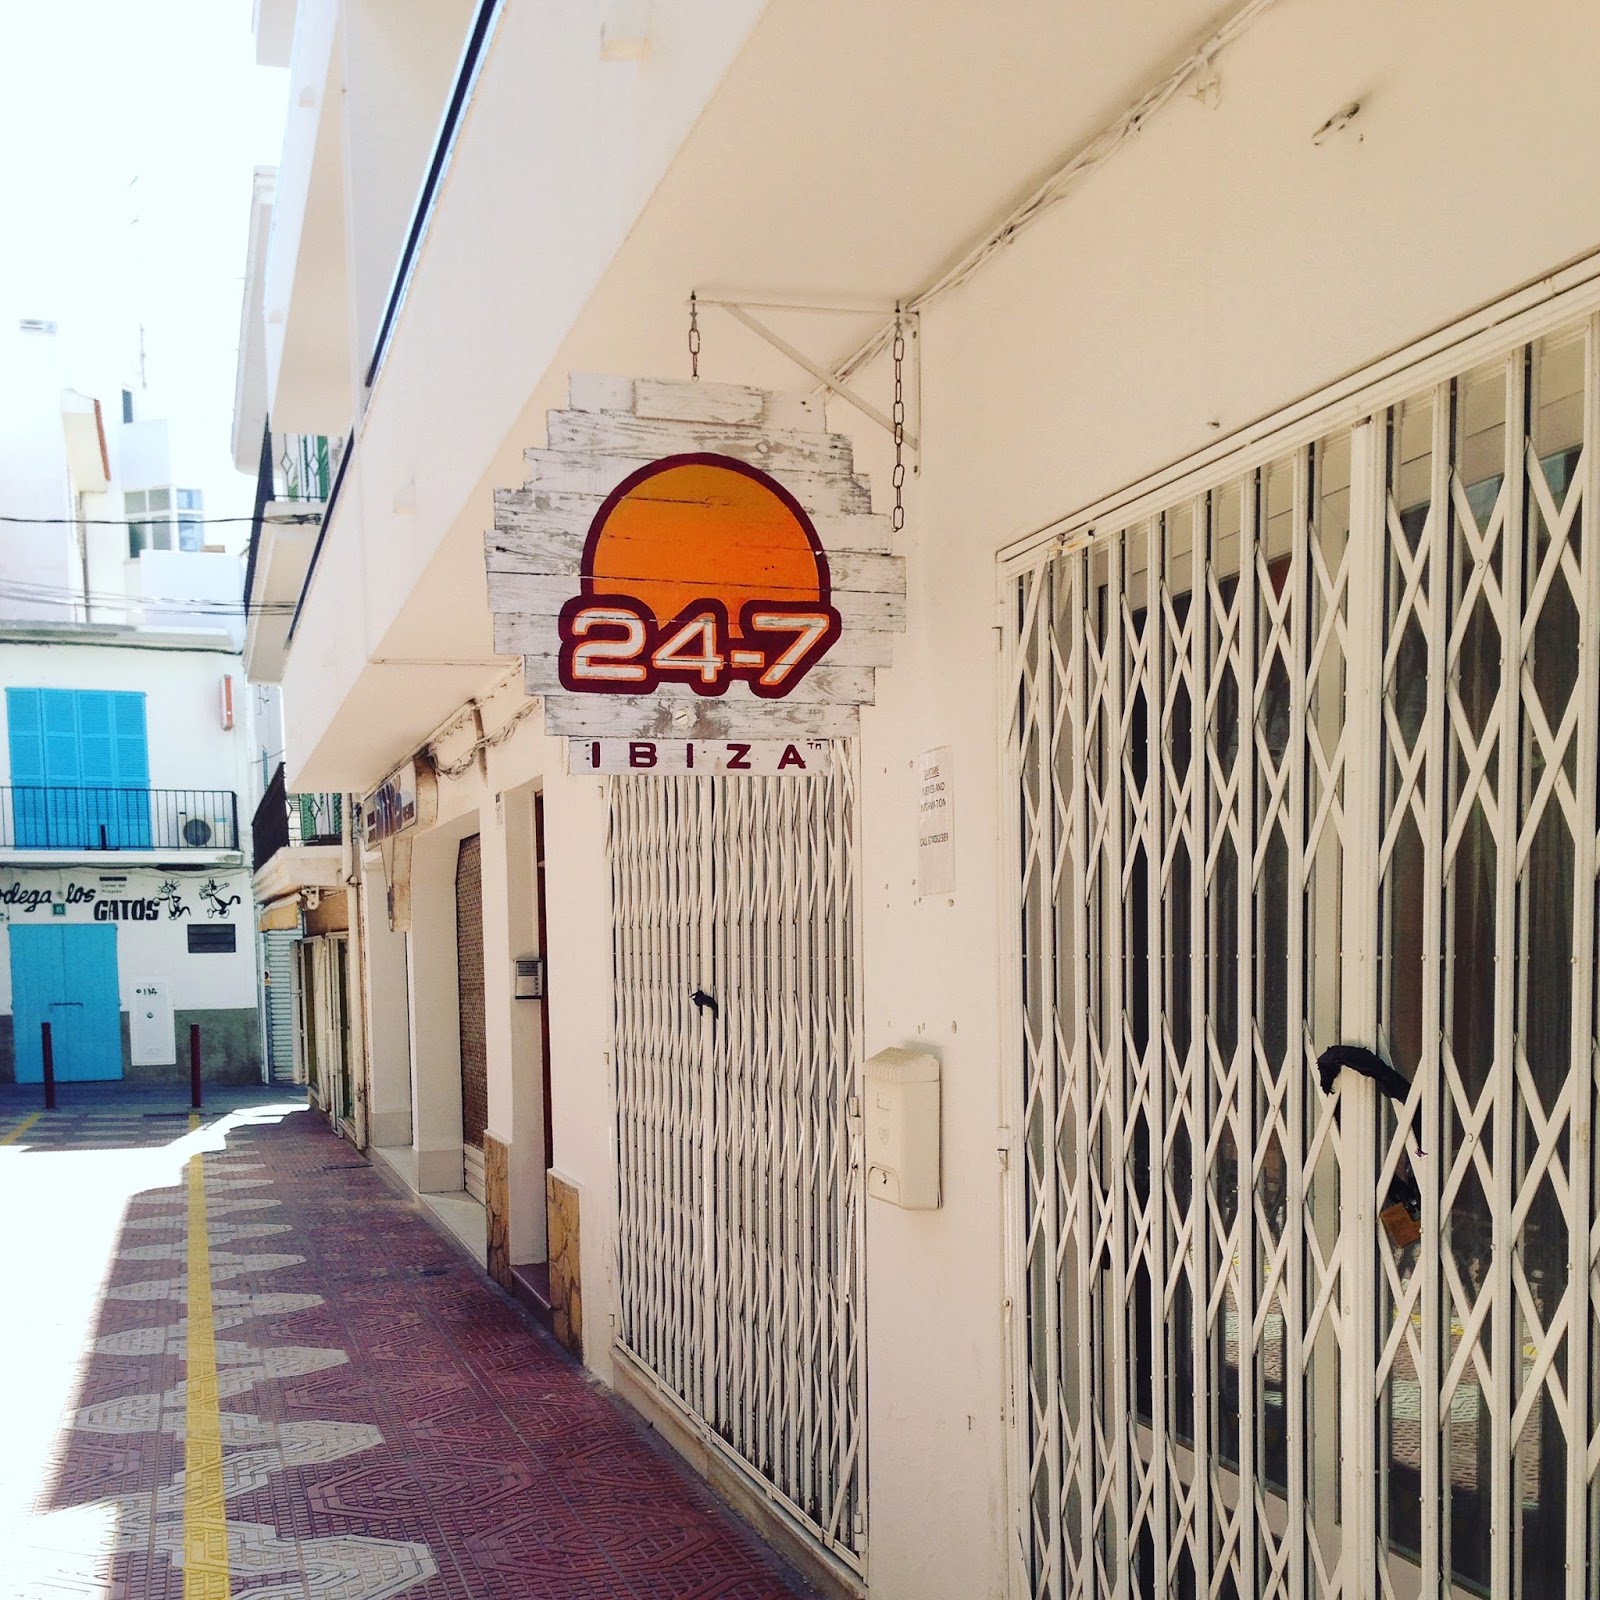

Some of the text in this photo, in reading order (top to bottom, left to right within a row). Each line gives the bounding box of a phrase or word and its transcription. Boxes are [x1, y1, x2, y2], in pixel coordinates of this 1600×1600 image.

[572, 607, 830, 686] 24-7
[591, 741, 806, 769] IBIZA
[94, 899, 160, 921] GATOS
